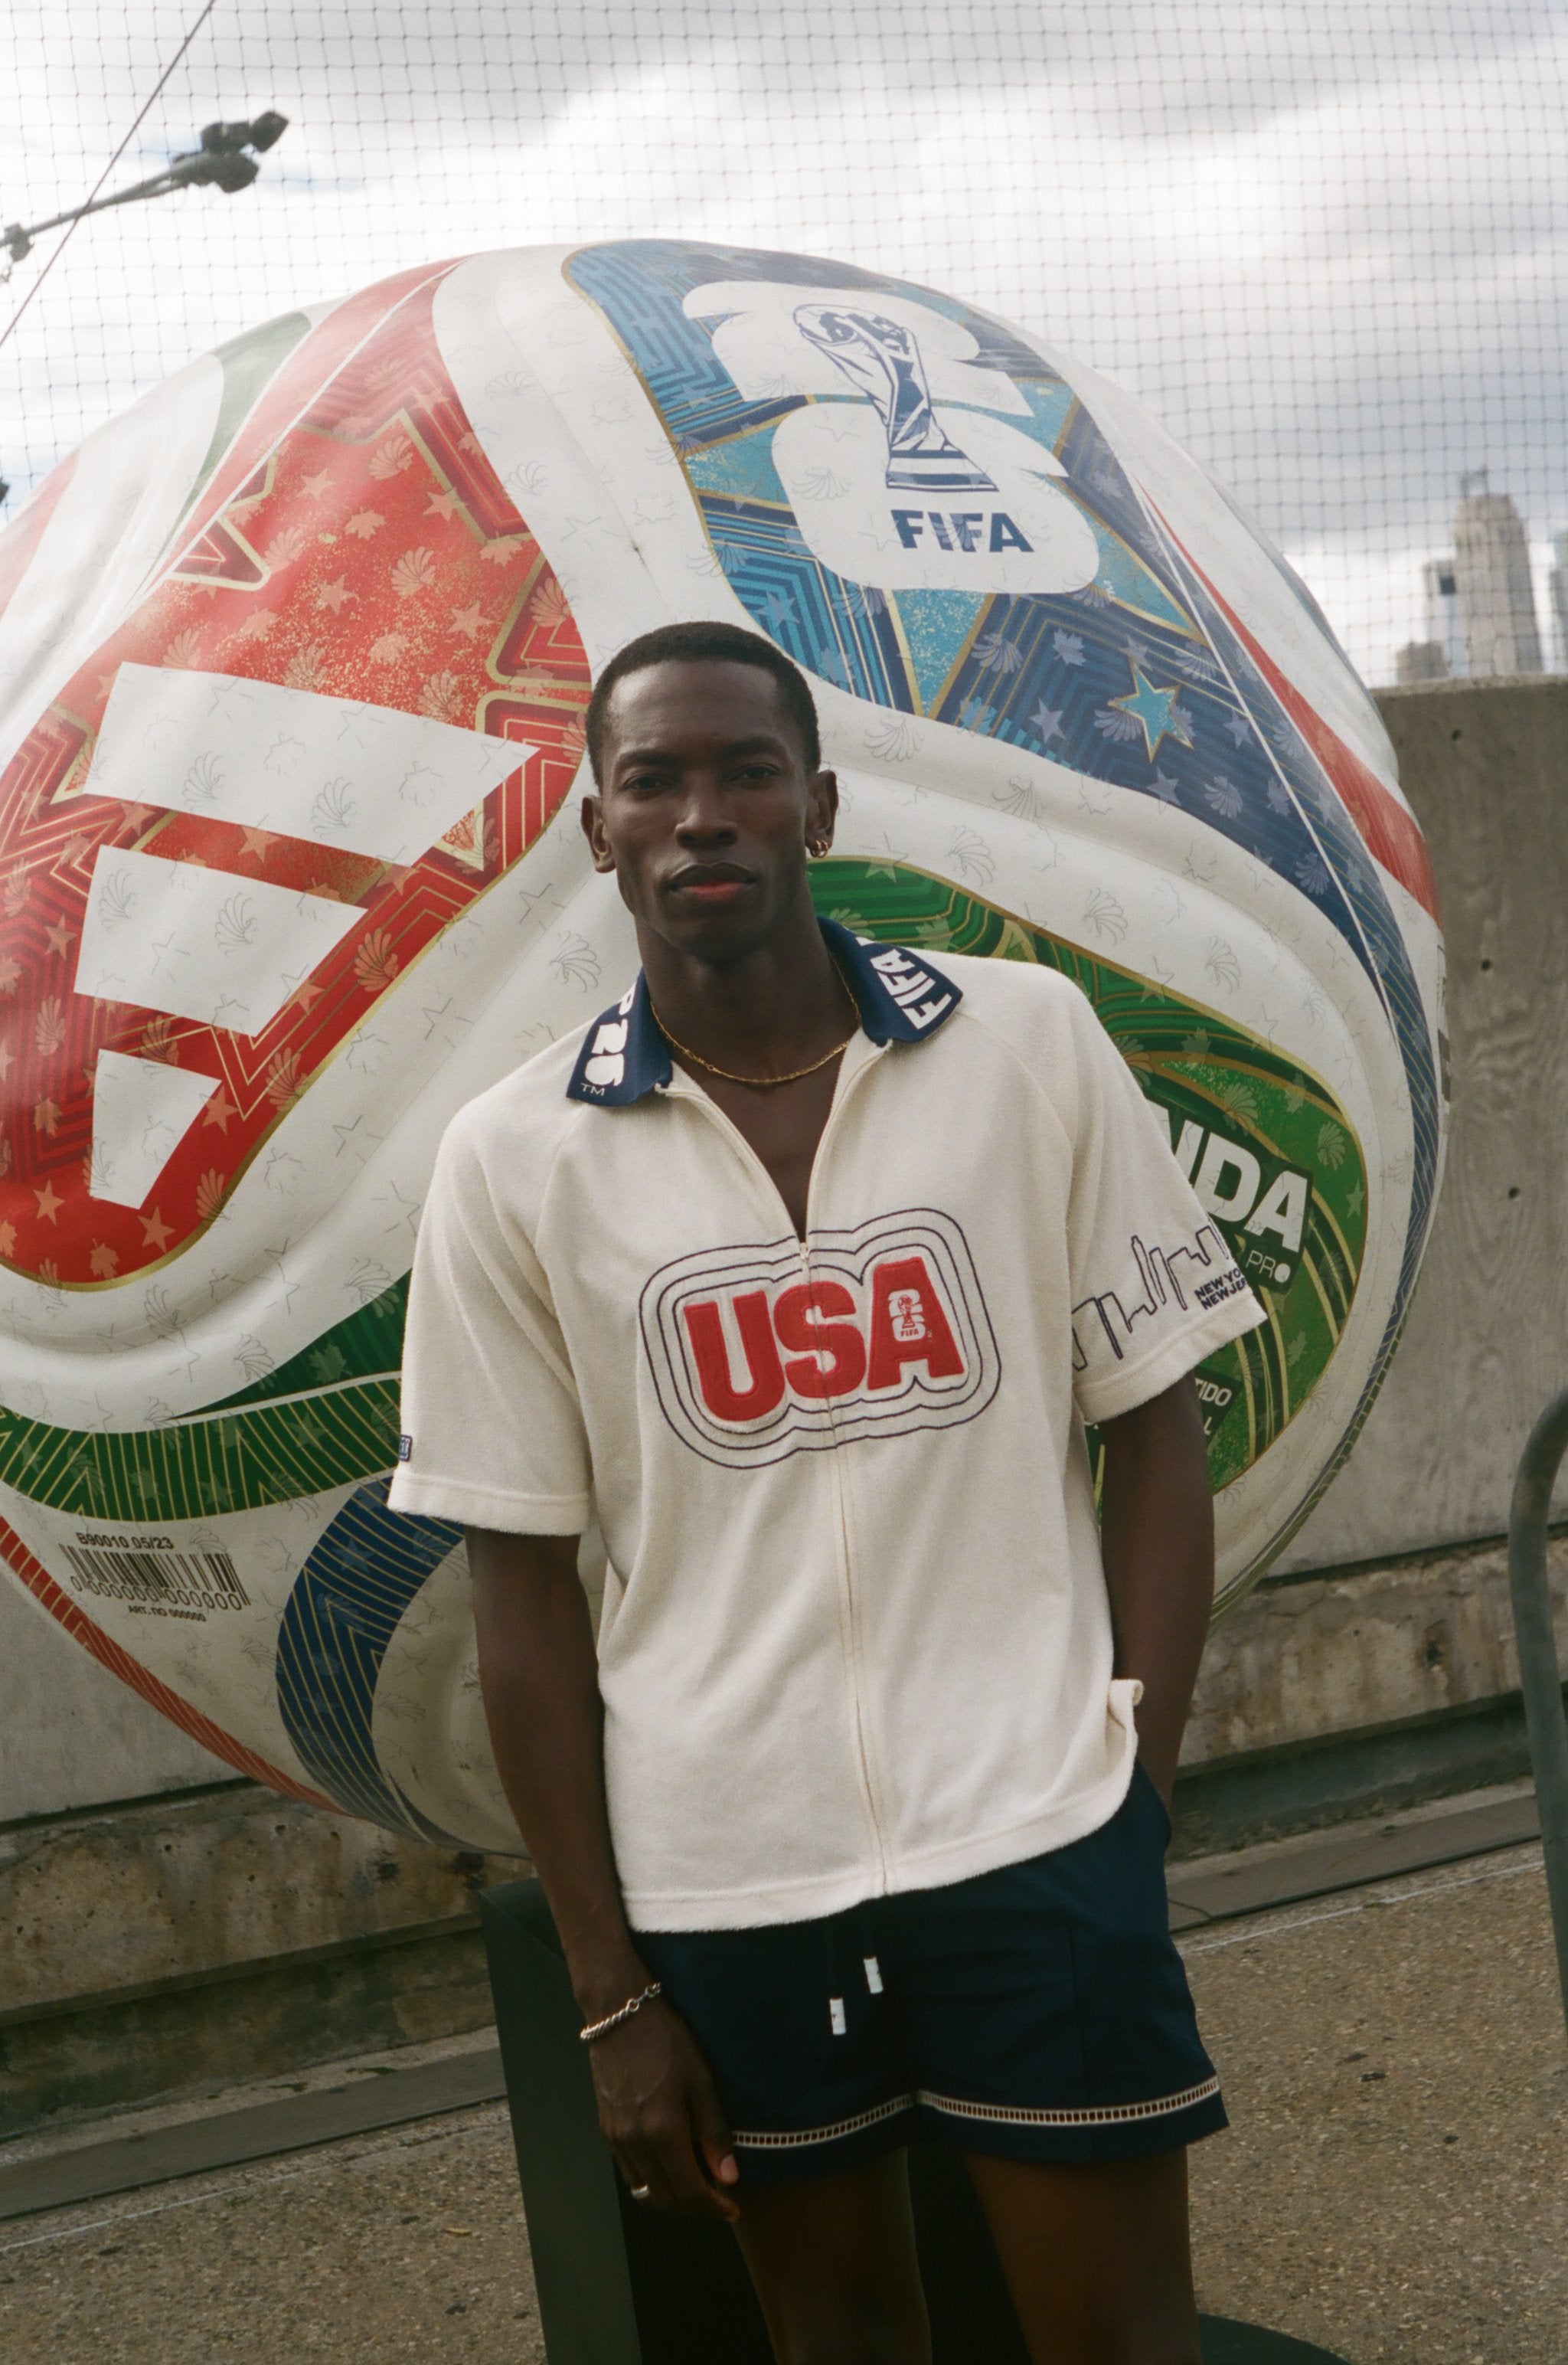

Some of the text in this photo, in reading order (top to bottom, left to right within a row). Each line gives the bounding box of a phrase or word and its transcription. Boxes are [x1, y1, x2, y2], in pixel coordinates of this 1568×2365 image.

[890, 509, 1035, 553] FIFA
[870, 948, 952, 1030] FIFA
[580, 1082, 606, 1097] TM
[1245, 1250, 1292, 1284] PRO
[1194, 1276, 1223, 1300] NEW
[1200, 1287, 1230, 1310] NEW
[683, 1255, 965, 1422] USA
[900, 1328, 920, 1337] FIFA
[75, 1532, 175, 1550] B90010 05/23
